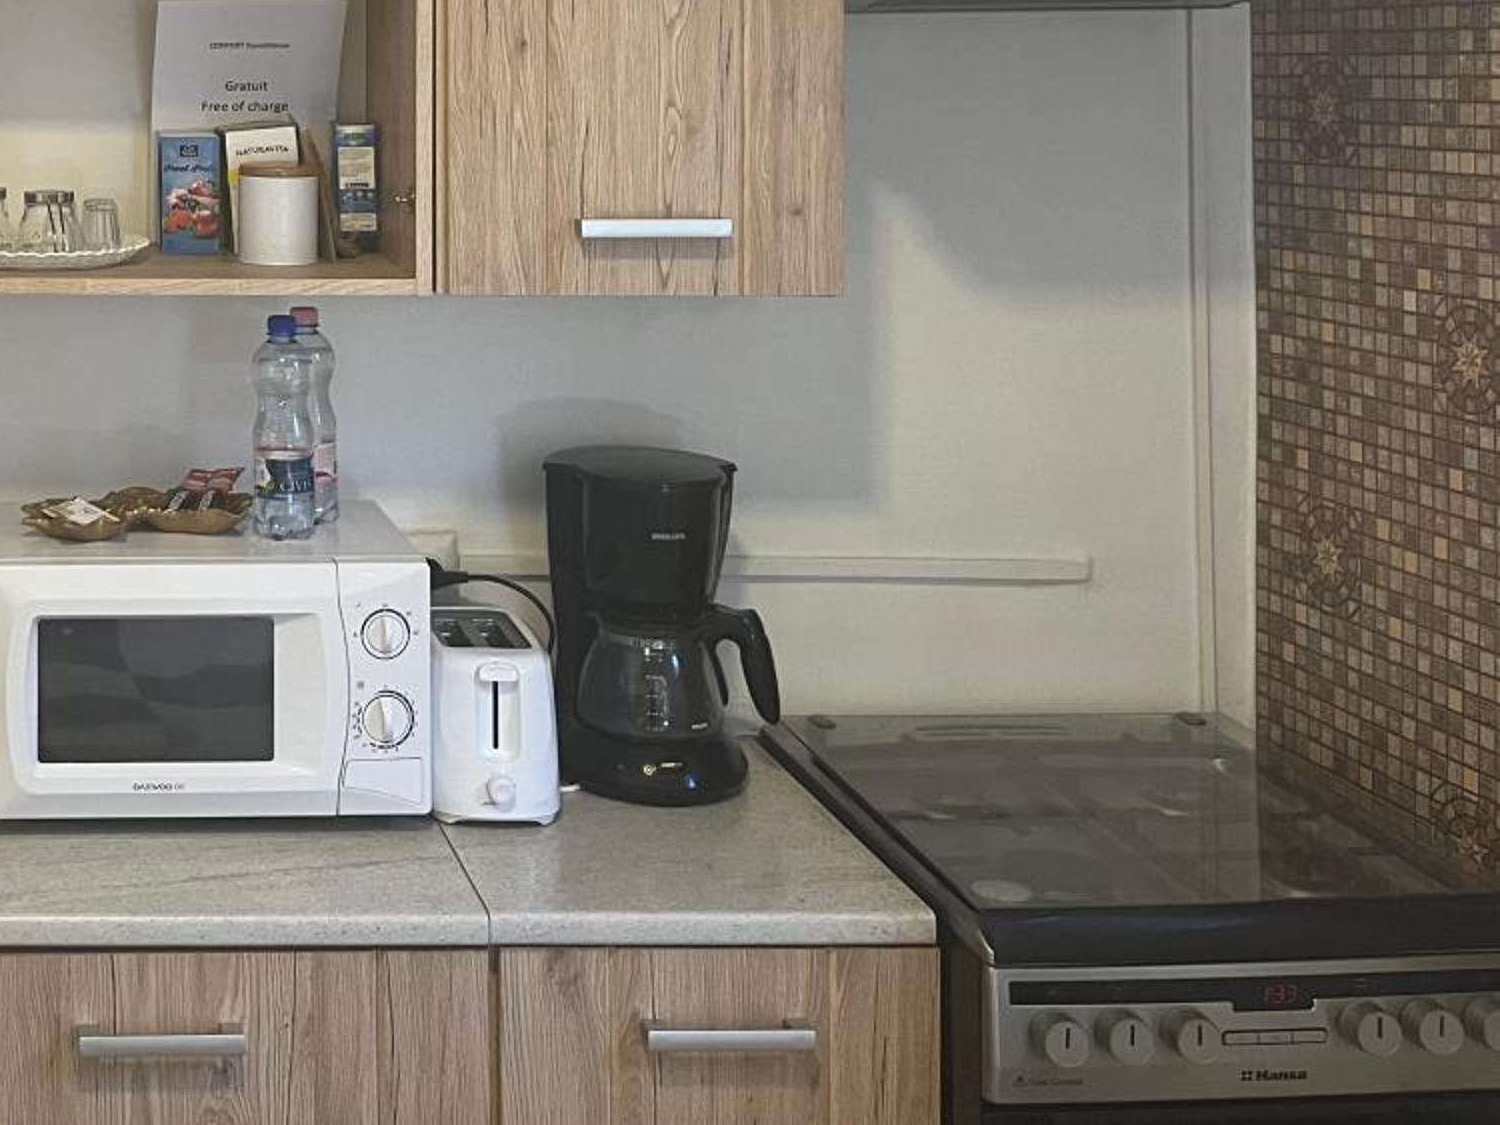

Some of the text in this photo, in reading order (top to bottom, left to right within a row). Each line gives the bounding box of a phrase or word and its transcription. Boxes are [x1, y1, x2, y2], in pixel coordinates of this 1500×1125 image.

[224, 80, 268, 92] Gratuit
[201, 100, 289, 114] Free of charge
[1255, 1069, 1307, 1082] Hansa
